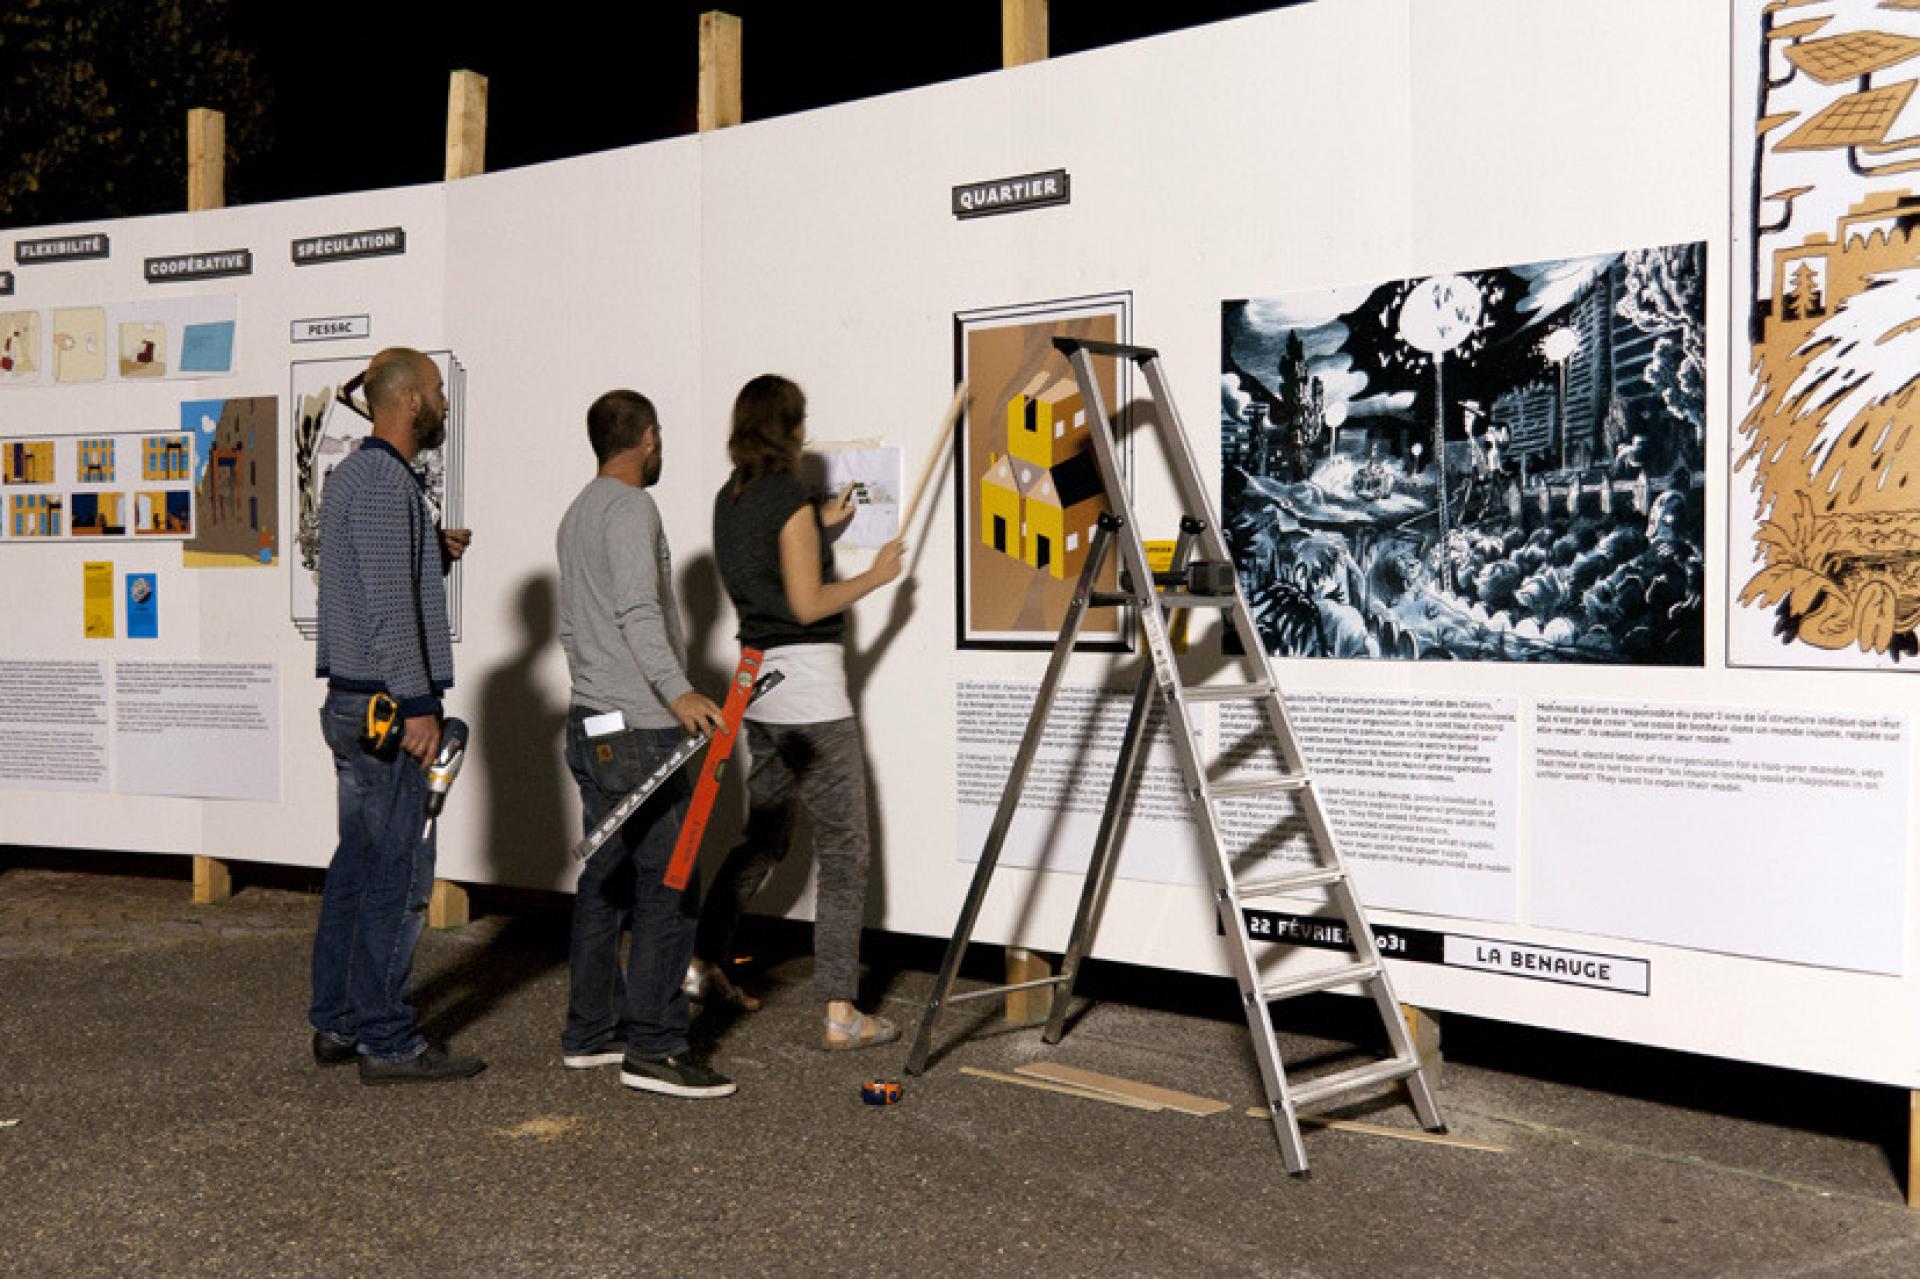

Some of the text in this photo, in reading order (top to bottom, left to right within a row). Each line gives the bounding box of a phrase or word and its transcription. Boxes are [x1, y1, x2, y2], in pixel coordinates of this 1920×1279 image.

[960, 178, 1057, 210] QUARTIER
[20, 235, 100, 256] FLEXIBILITÉ
[297, 232, 396, 257] SPÉCULATION
[149, 254, 245, 275] COOPÉRATIVE
[308, 321, 353, 336] PESSAC
[1250, 915, 1271, 935] 22
[1476, 946, 1611, 981] LA BENAUGE
